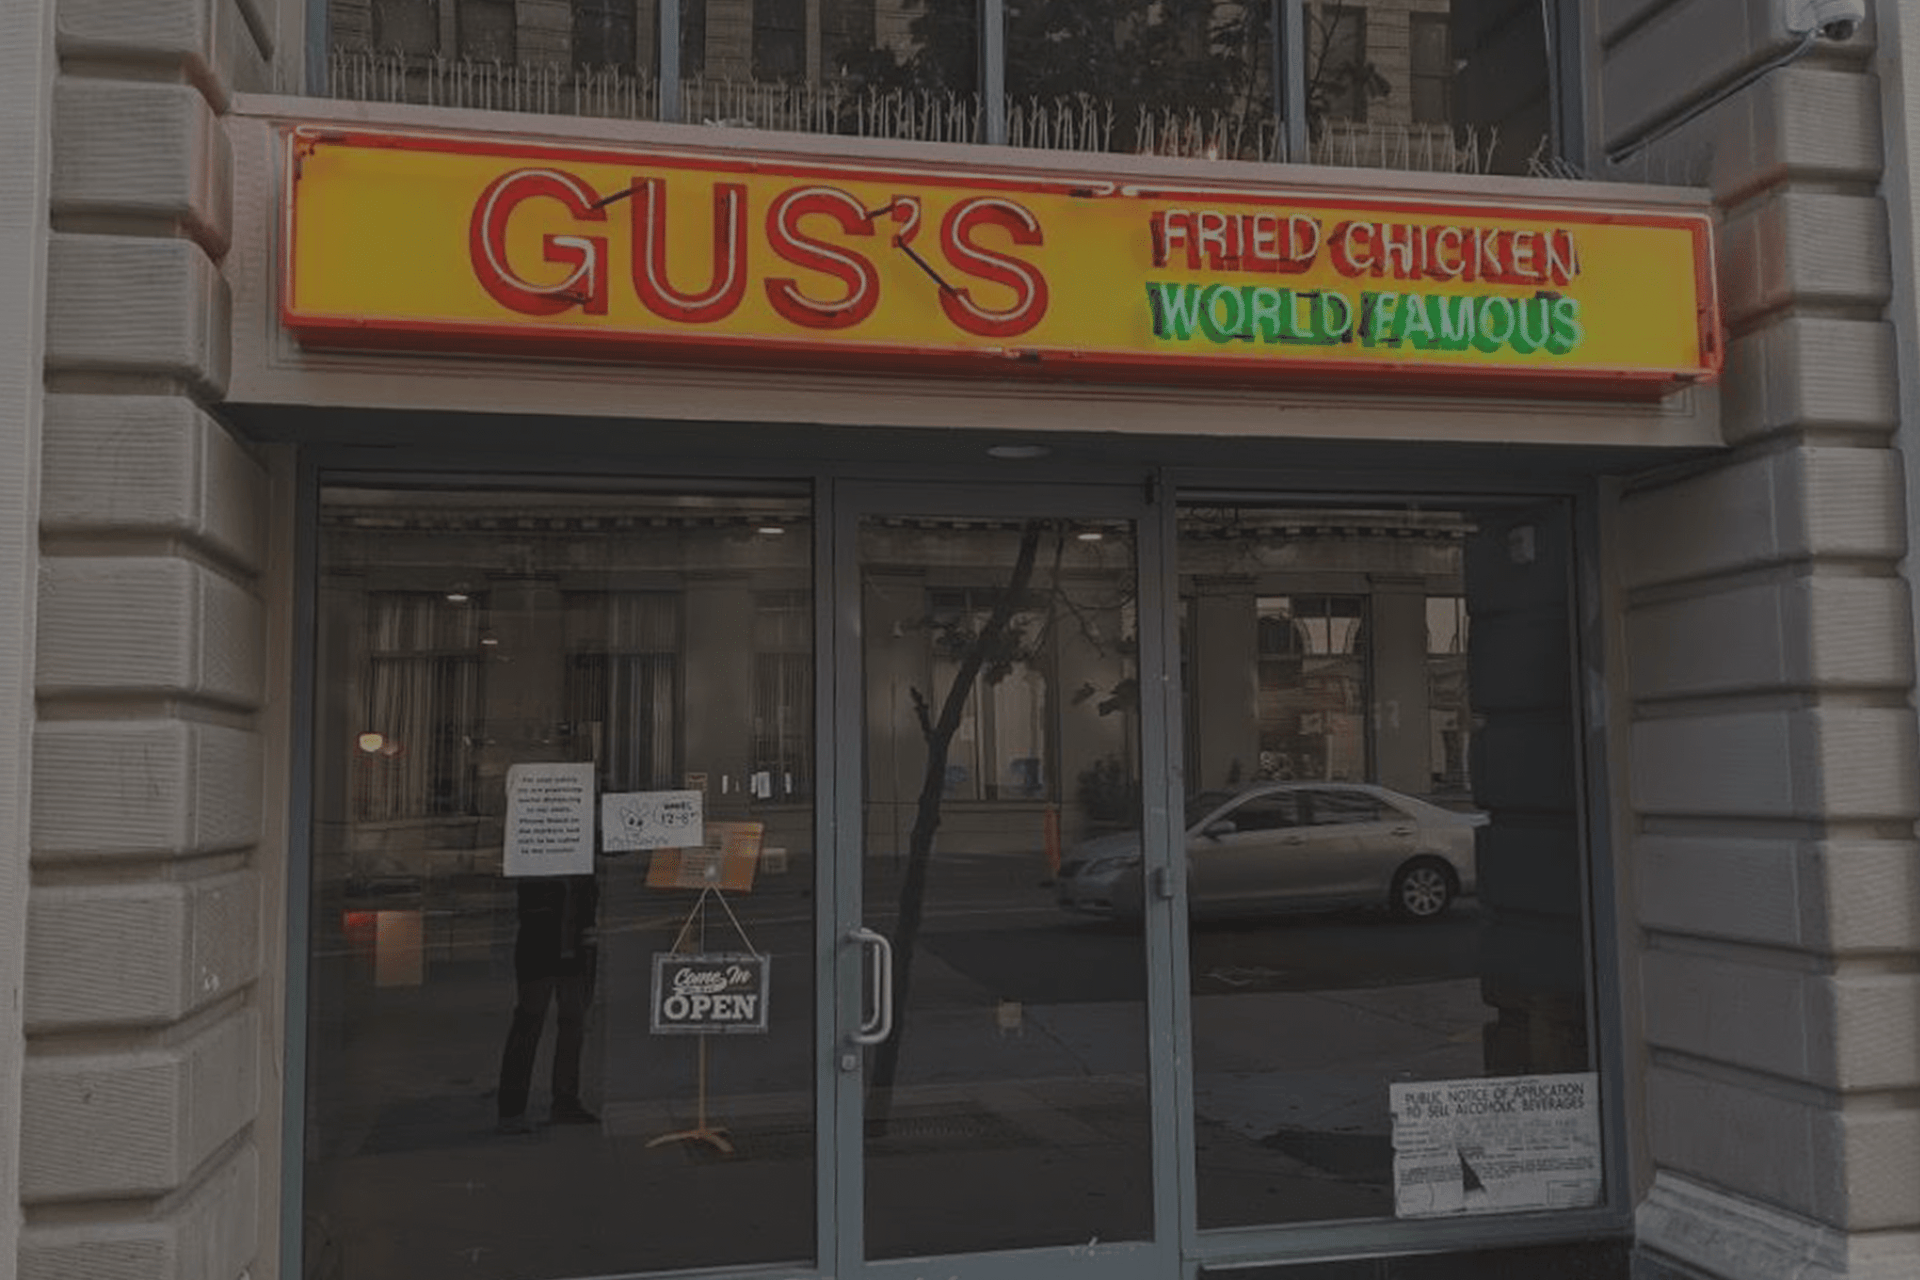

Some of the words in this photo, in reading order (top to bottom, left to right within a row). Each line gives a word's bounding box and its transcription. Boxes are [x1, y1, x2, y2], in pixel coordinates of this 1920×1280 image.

[469, 168, 1048, 338] GUS'S
[1150, 209, 1322, 274] FRIED
[1328, 220, 1581, 286] CHICKEN
[1146, 281, 1353, 345] WORLD
[1358, 290, 1583, 354] FAMOUS
[673, 967, 727, 990] Come
[725, 965, 752, 984] In
[663, 994, 757, 1020] OPEN
[1448, 1089, 1488, 1102] NOTICE
[1493, 1087, 1508, 1100] OF
[1514, 1082, 1584, 1097] APPLICATION
[1406, 1105, 1421, 1118] TO
[1428, 1104, 1450, 1118] SELL
[1456, 1099, 1516, 1114] ALCOHOLIC
[1522, 1096, 1584, 1111] BEVERAGES
